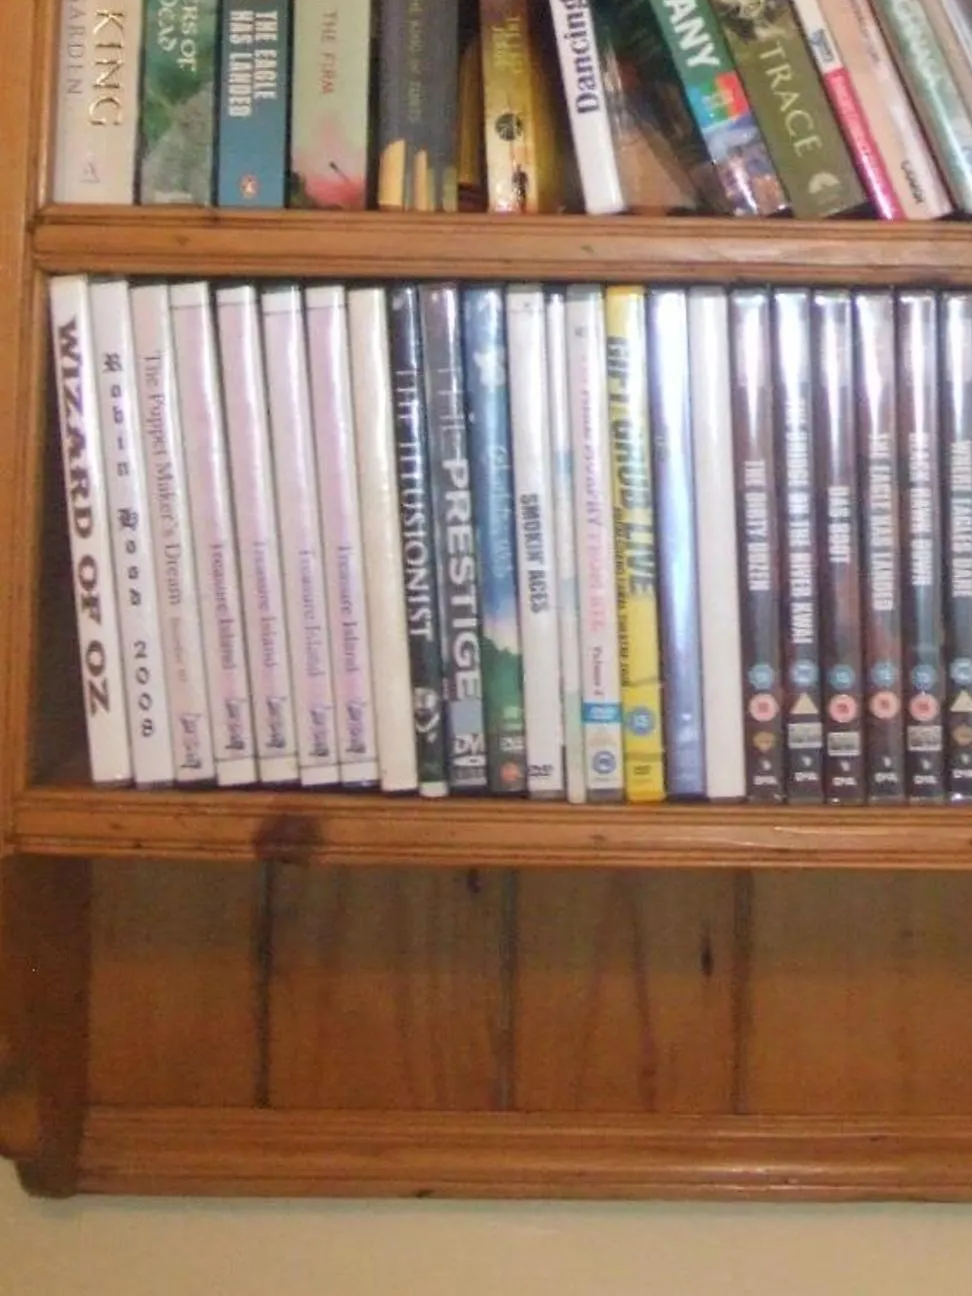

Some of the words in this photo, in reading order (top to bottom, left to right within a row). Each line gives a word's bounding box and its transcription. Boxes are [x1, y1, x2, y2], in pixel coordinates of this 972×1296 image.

[229, 10, 253, 44] HAS
[254, 10, 279, 41] THE
[321, 10, 339, 42] THE
[88, 9, 127, 126] KING
[228, 52, 252, 116] LANDED
[254, 48, 278, 99] EAGLE
[320, 52, 338, 94] FIRM
[759, 40, 822, 158] TRACE
[143, 349, 163, 388] The
[396, 369, 420, 423] THE
[57, 317, 95, 540] WIZARD
[145, 394, 169, 456] Puppet
[869, 433, 891, 459] THE
[745, 460, 766, 487] THE
[869, 464, 893, 509] EAGLE
[951, 439, 972, 491] WHERE
[154, 461, 179, 538] Maker's
[745, 492, 768, 537] DIRTY
[828, 485, 850, 516] DAS
[910, 487, 933, 533] HAWK
[399, 440, 433, 643] ILLUSIONIST
[519, 493, 543, 562] SMOKIN'
[790, 519, 811, 546] THE
[828, 522, 851, 564] BOOT
[871, 514, 894, 546] HAS
[164, 543, 183, 607] Dream
[210, 543, 229, 613] Treasure
[251, 539, 272, 611] Treasure
[297, 548, 317, 620] Treasure
[336, 544, 354, 616] Treasure
[442, 457, 481, 700] PRESTIGE
[622, 523, 659, 602] LIVE
[748, 543, 771, 591] DOZEN
[789, 552, 812, 597] RIVER
[871, 551, 894, 611] LANDED
[911, 538, 934, 586] DOWN
[78, 555, 102, 626] OF
[528, 569, 549, 614] ACES
[218, 618, 234, 671] Island
[260, 616, 278, 669] Island
[342, 621, 360, 673] Island
[791, 601, 813, 643] KWAI
[305, 625, 324, 678] Island
[86, 640, 111, 719] OZ
[133, 640, 157, 737] 2008
